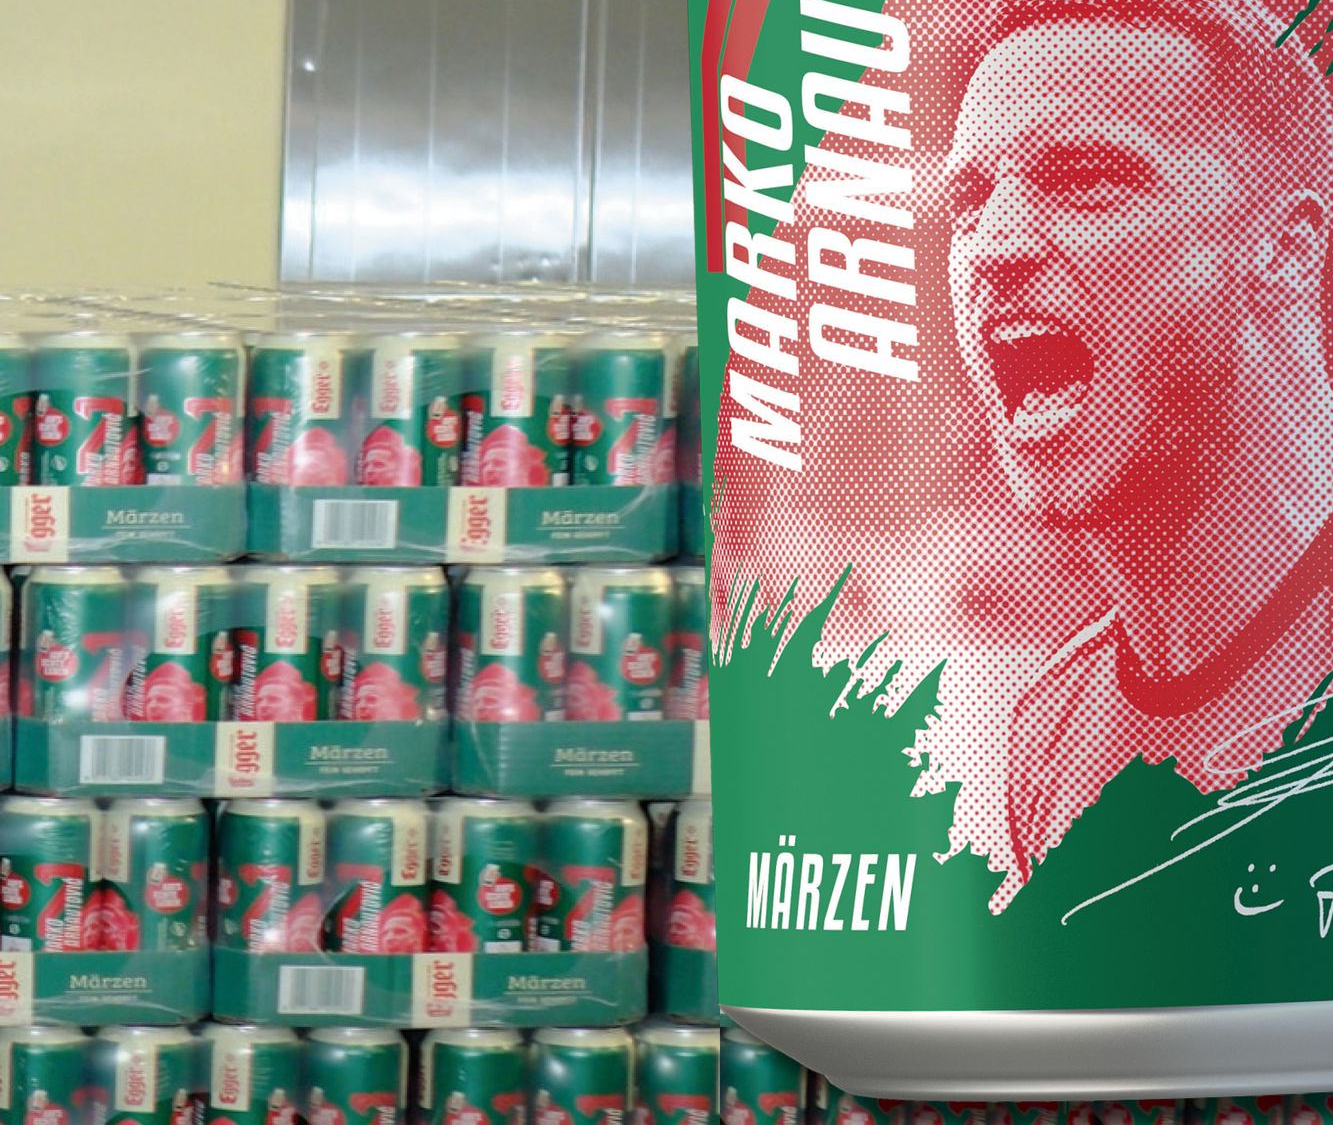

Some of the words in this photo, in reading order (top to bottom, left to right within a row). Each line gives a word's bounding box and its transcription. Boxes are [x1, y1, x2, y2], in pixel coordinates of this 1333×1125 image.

[720, 73, 803, 473] MARKO
[106, 508, 184, 525] Märzen
[747, 835, 920, 932] MÄRZEN
[69, 974, 148, 990] Märzen
[507, 975, 586, 991] Märzen
